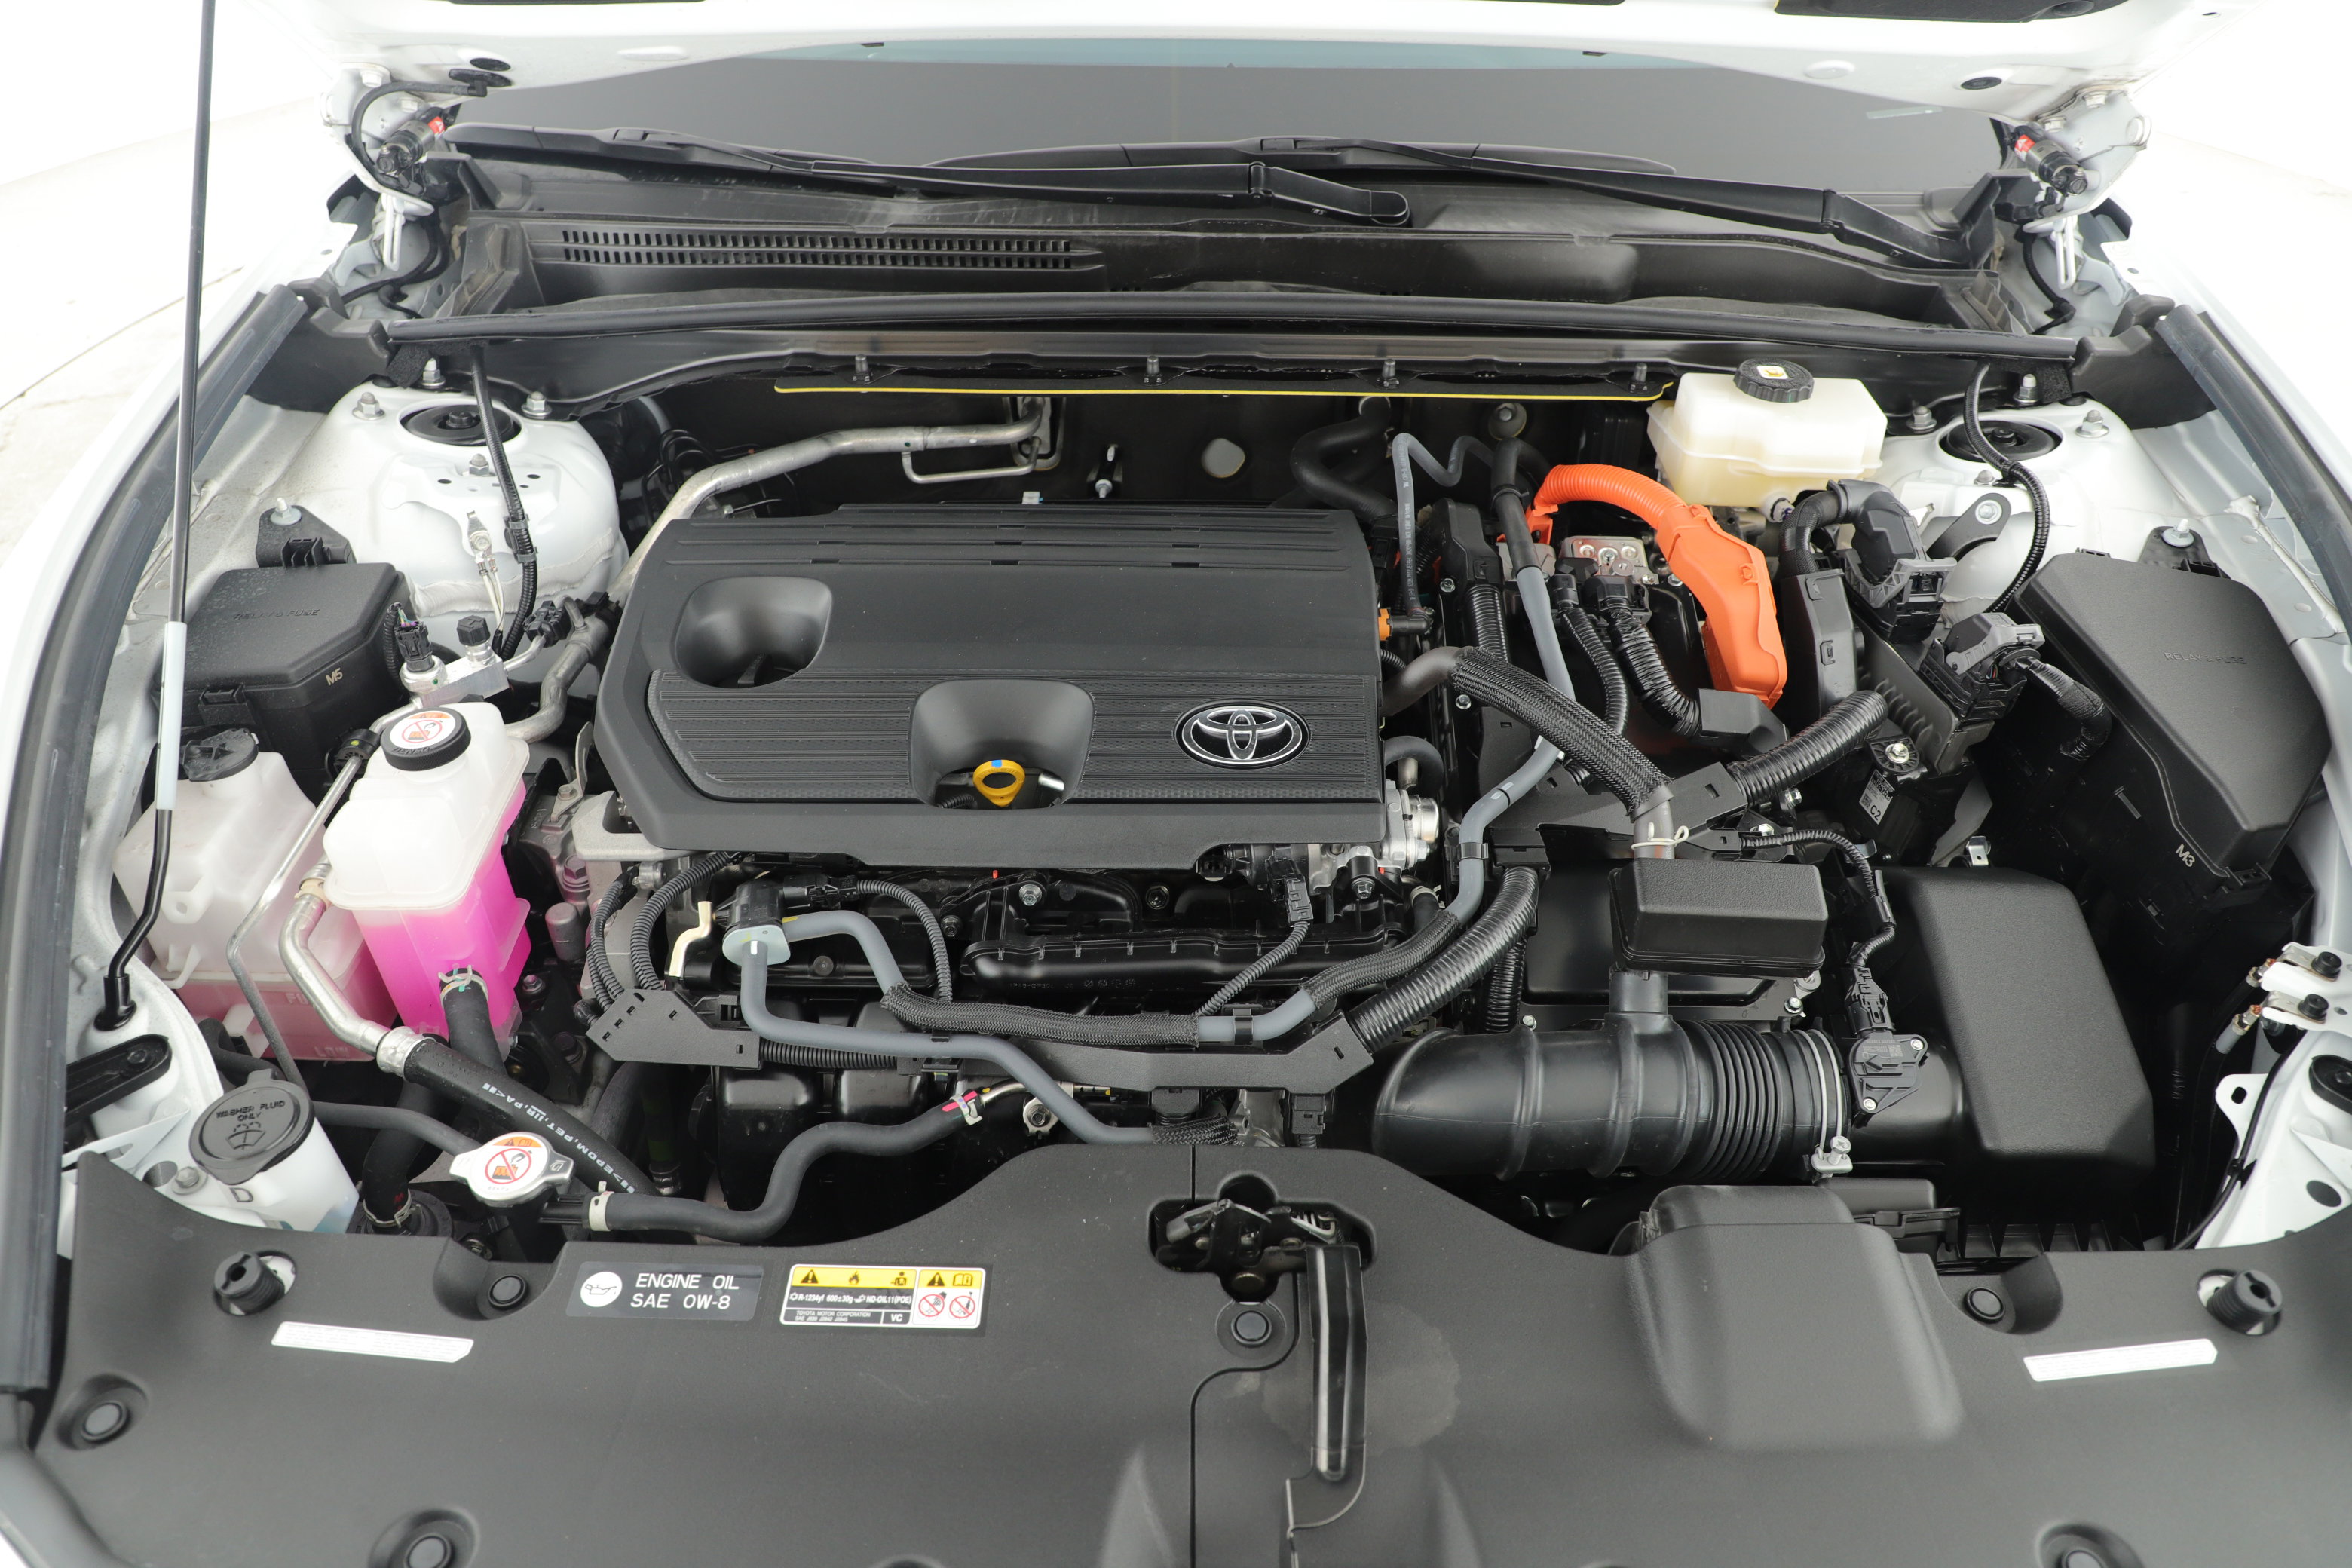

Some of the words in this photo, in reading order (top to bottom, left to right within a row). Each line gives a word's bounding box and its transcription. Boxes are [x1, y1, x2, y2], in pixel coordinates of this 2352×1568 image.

[286, 608, 320, 617] FUSE
[2163, 651, 2202, 662] RELAY
[2216, 655, 2247, 664] FUSE
[325, 667, 344, 686] M5
[1870, 804, 1882, 821] C2
[2175, 844, 2195, 868] M3
[216, 1105, 256, 1119] WASHER
[260, 1100, 286, 1110] FLUID
[237, 1111, 262, 1122] ONLY
[635, 1272, 702, 1289] ENGINE
[712, 1275, 740, 1290] OIL
[630, 1293, 672, 1309] SAE
[890, 1314, 903, 1322] VC
